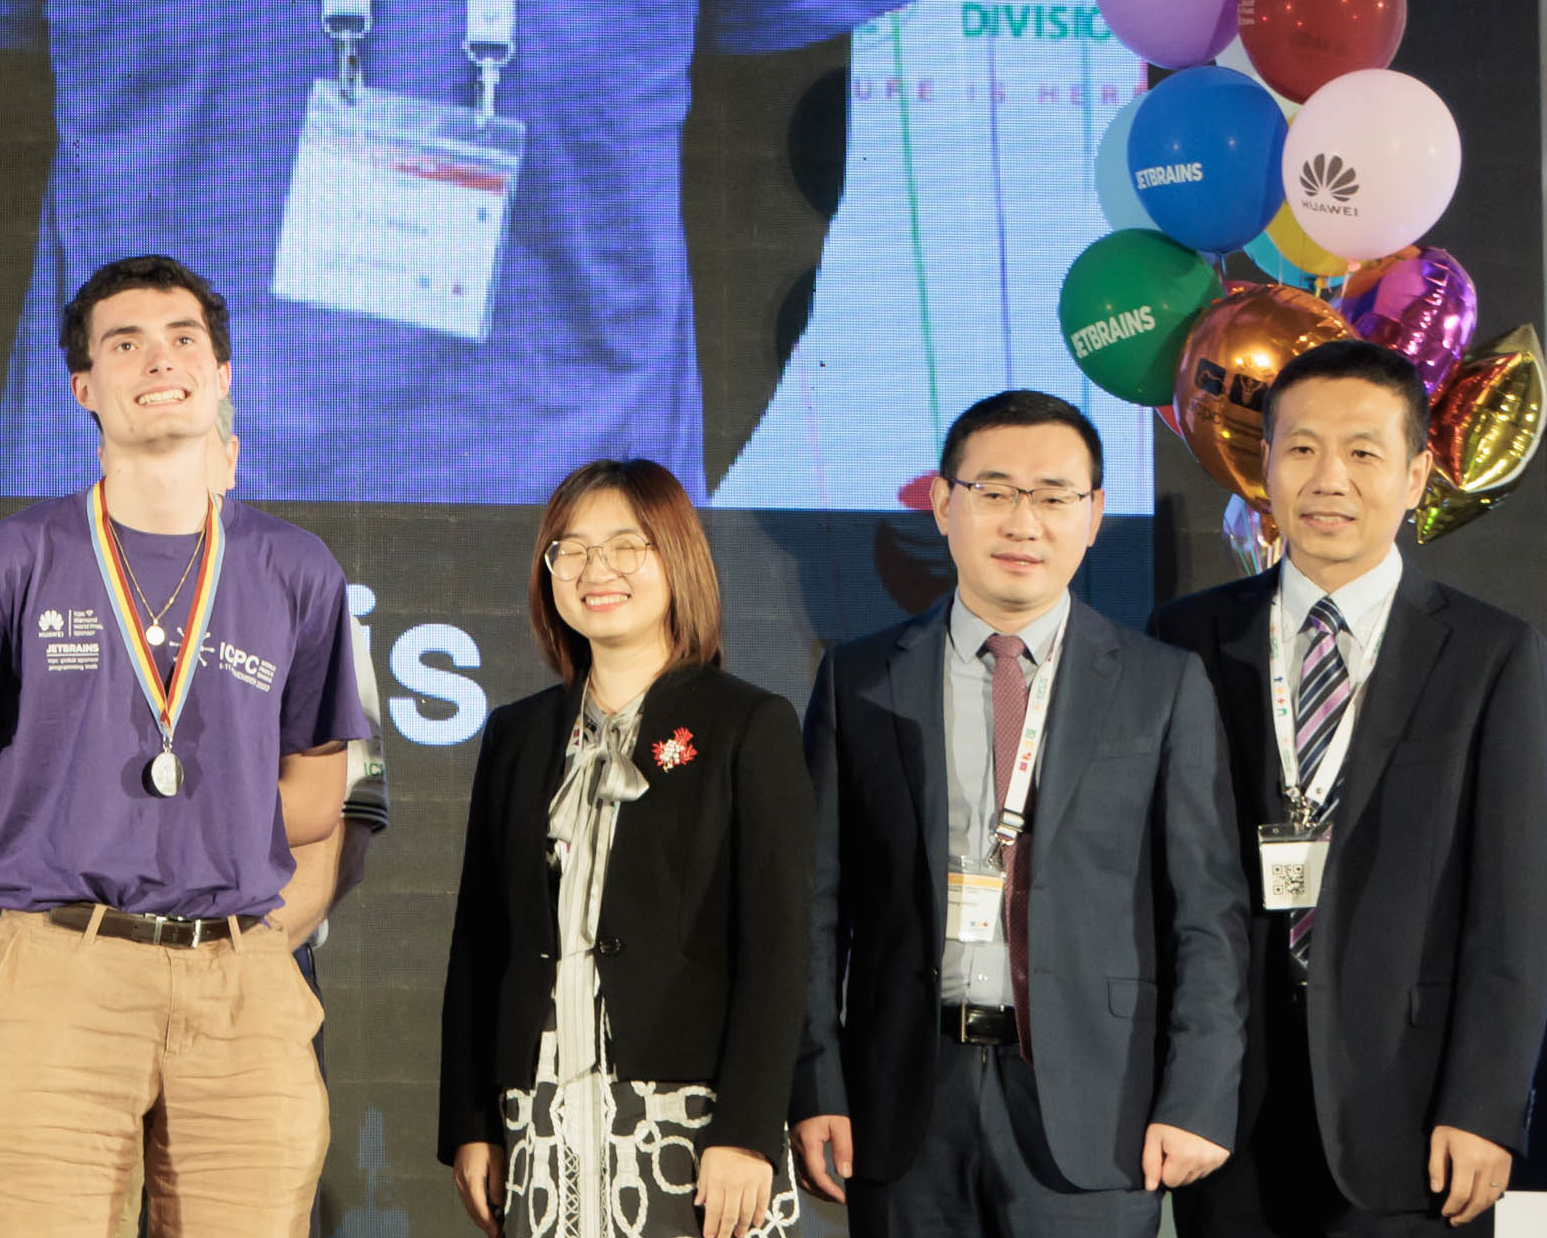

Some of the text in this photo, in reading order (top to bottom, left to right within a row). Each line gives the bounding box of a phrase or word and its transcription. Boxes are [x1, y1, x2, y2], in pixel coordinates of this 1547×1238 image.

[1135, 162, 1204, 191] JETBRAINS
[1300, 199, 1360, 218] HUAWEI
[1071, 306, 1156, 359] JETBRAINS
[46, 643, 99, 653] JETBRAINS
[219, 641, 260, 675] ICPC
